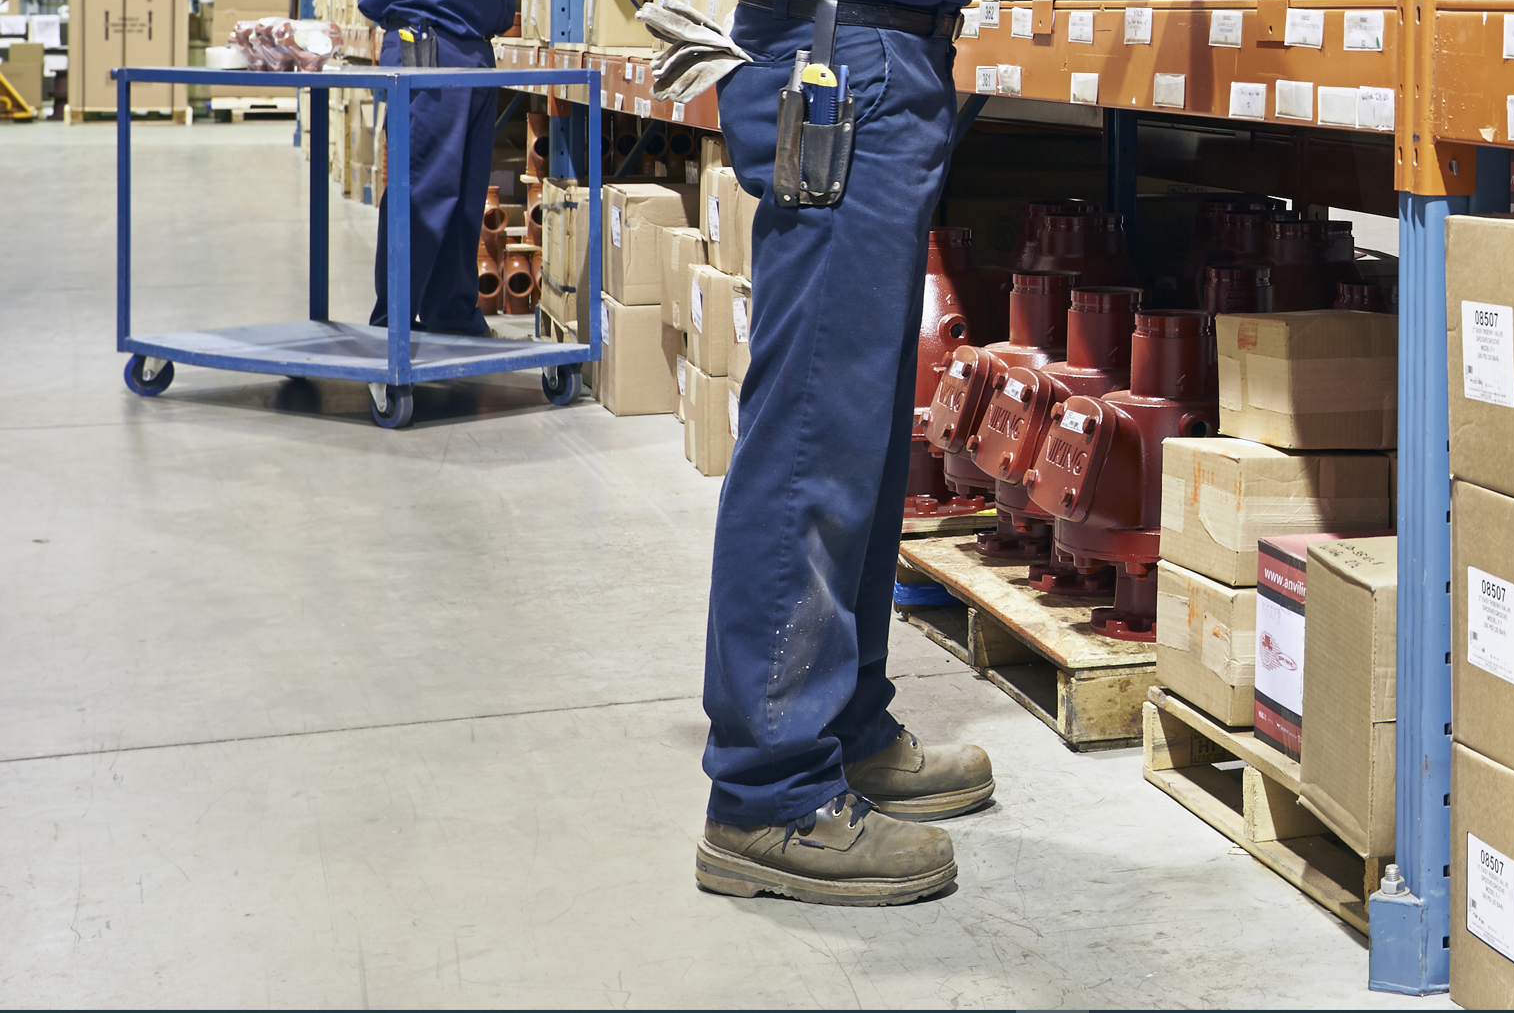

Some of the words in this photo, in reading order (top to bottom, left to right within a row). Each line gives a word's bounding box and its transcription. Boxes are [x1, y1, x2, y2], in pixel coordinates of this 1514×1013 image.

[1475, 310, 1498, 327] 08507
[938, 382, 964, 412] VIKING
[988, 404, 1024, 440] VIKING
[1046, 435, 1088, 475] VIKING
[1481, 579, 1506, 602] 08507
[1481, 849, 1504, 876] 08507
